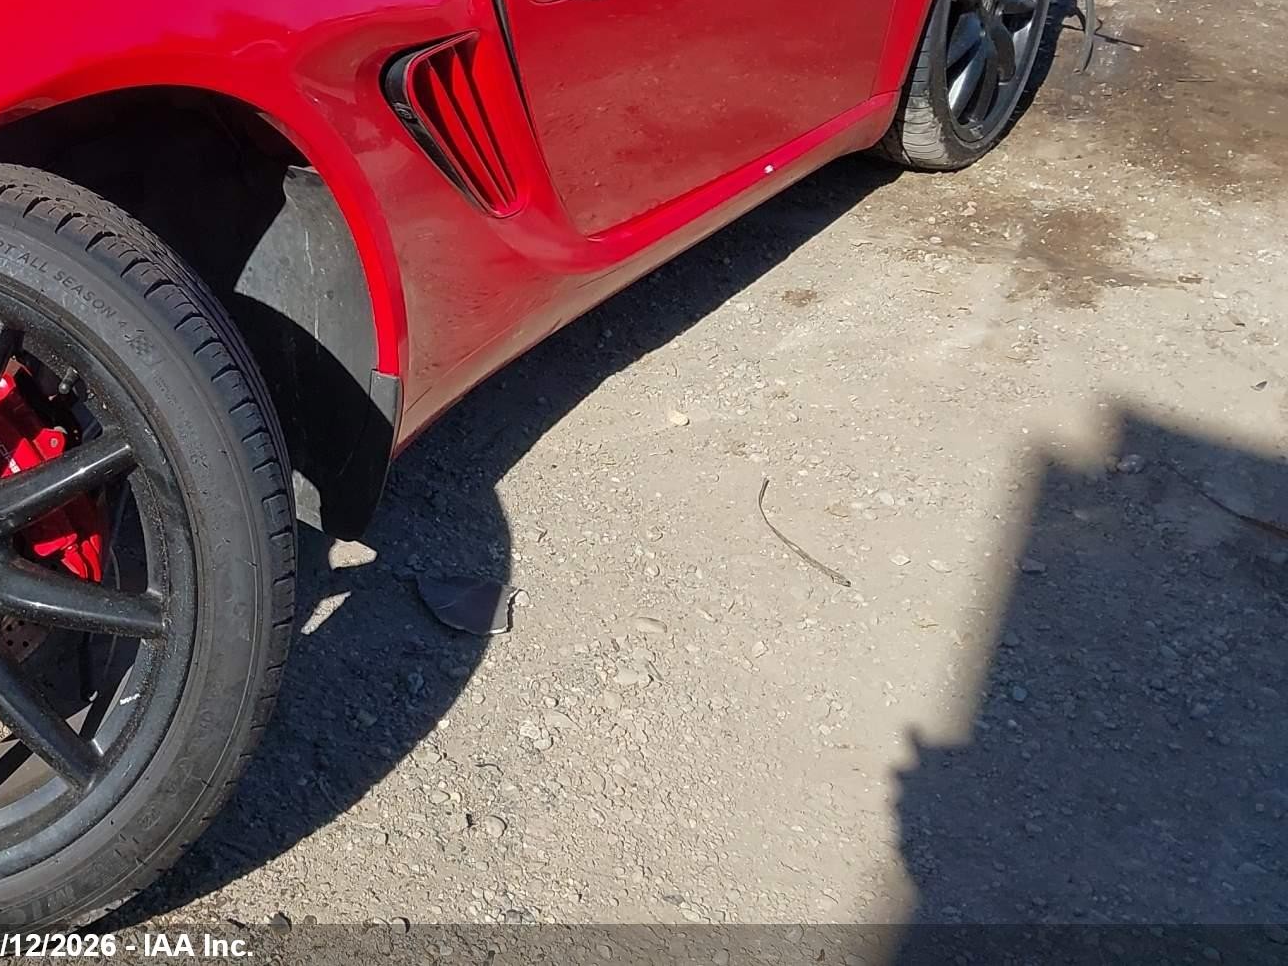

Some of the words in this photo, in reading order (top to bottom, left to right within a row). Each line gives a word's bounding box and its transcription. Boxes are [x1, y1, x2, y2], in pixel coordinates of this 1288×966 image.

[18, 252, 48, 273] ALL
[53, 270, 117, 318] SEASON
[118, 320, 128, 329] 4
